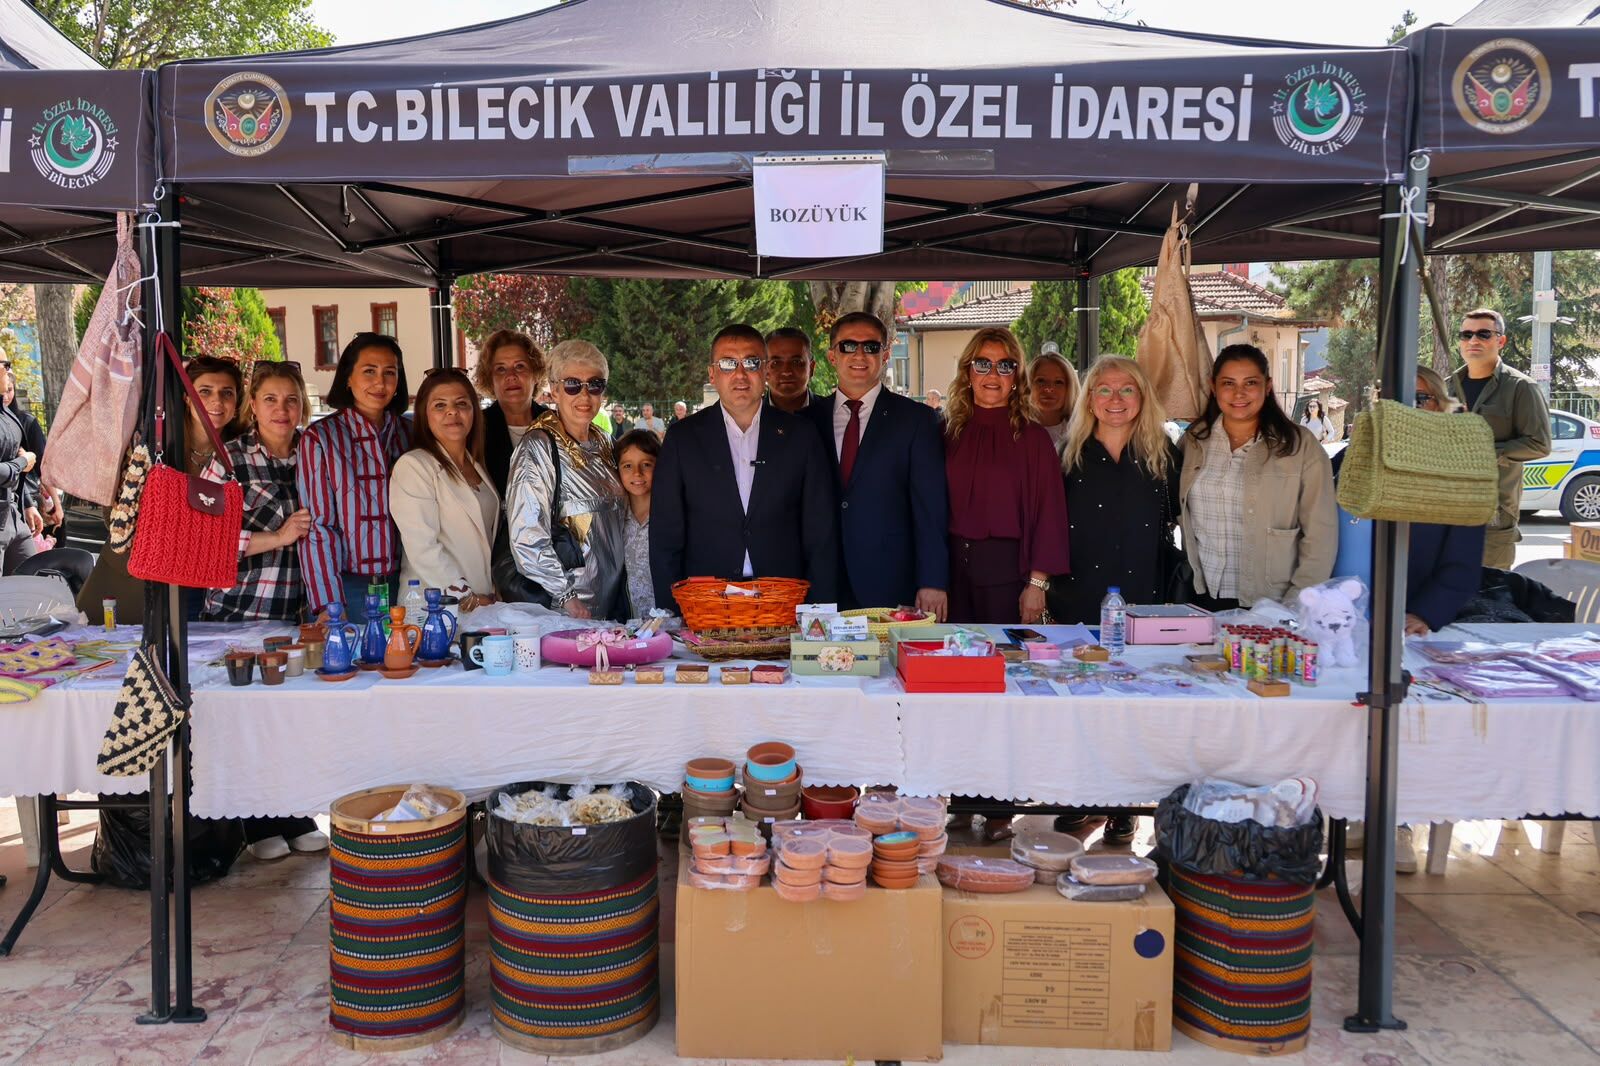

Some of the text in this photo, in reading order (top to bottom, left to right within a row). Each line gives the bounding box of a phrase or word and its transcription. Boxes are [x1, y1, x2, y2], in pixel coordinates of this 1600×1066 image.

[1285, 64, 1320, 87] ÖZEL
[1322, 60, 1366, 100] İDARESİ
[43, 100, 75, 121] ÖZEL
[77, 97, 119, 136] İDARESİ
[608, 68, 821, 138] VALİLİĞİ
[840, 70, 885, 137] İL
[901, 72, 1033, 139] ÖZEL
[1050, 72, 1254, 142] İDARESİ
[1289, 138, 1344, 156] BİLECİK
[48, 171, 99, 189] BİLECİK
[770, 205, 867, 223] BOZÜYÜK
